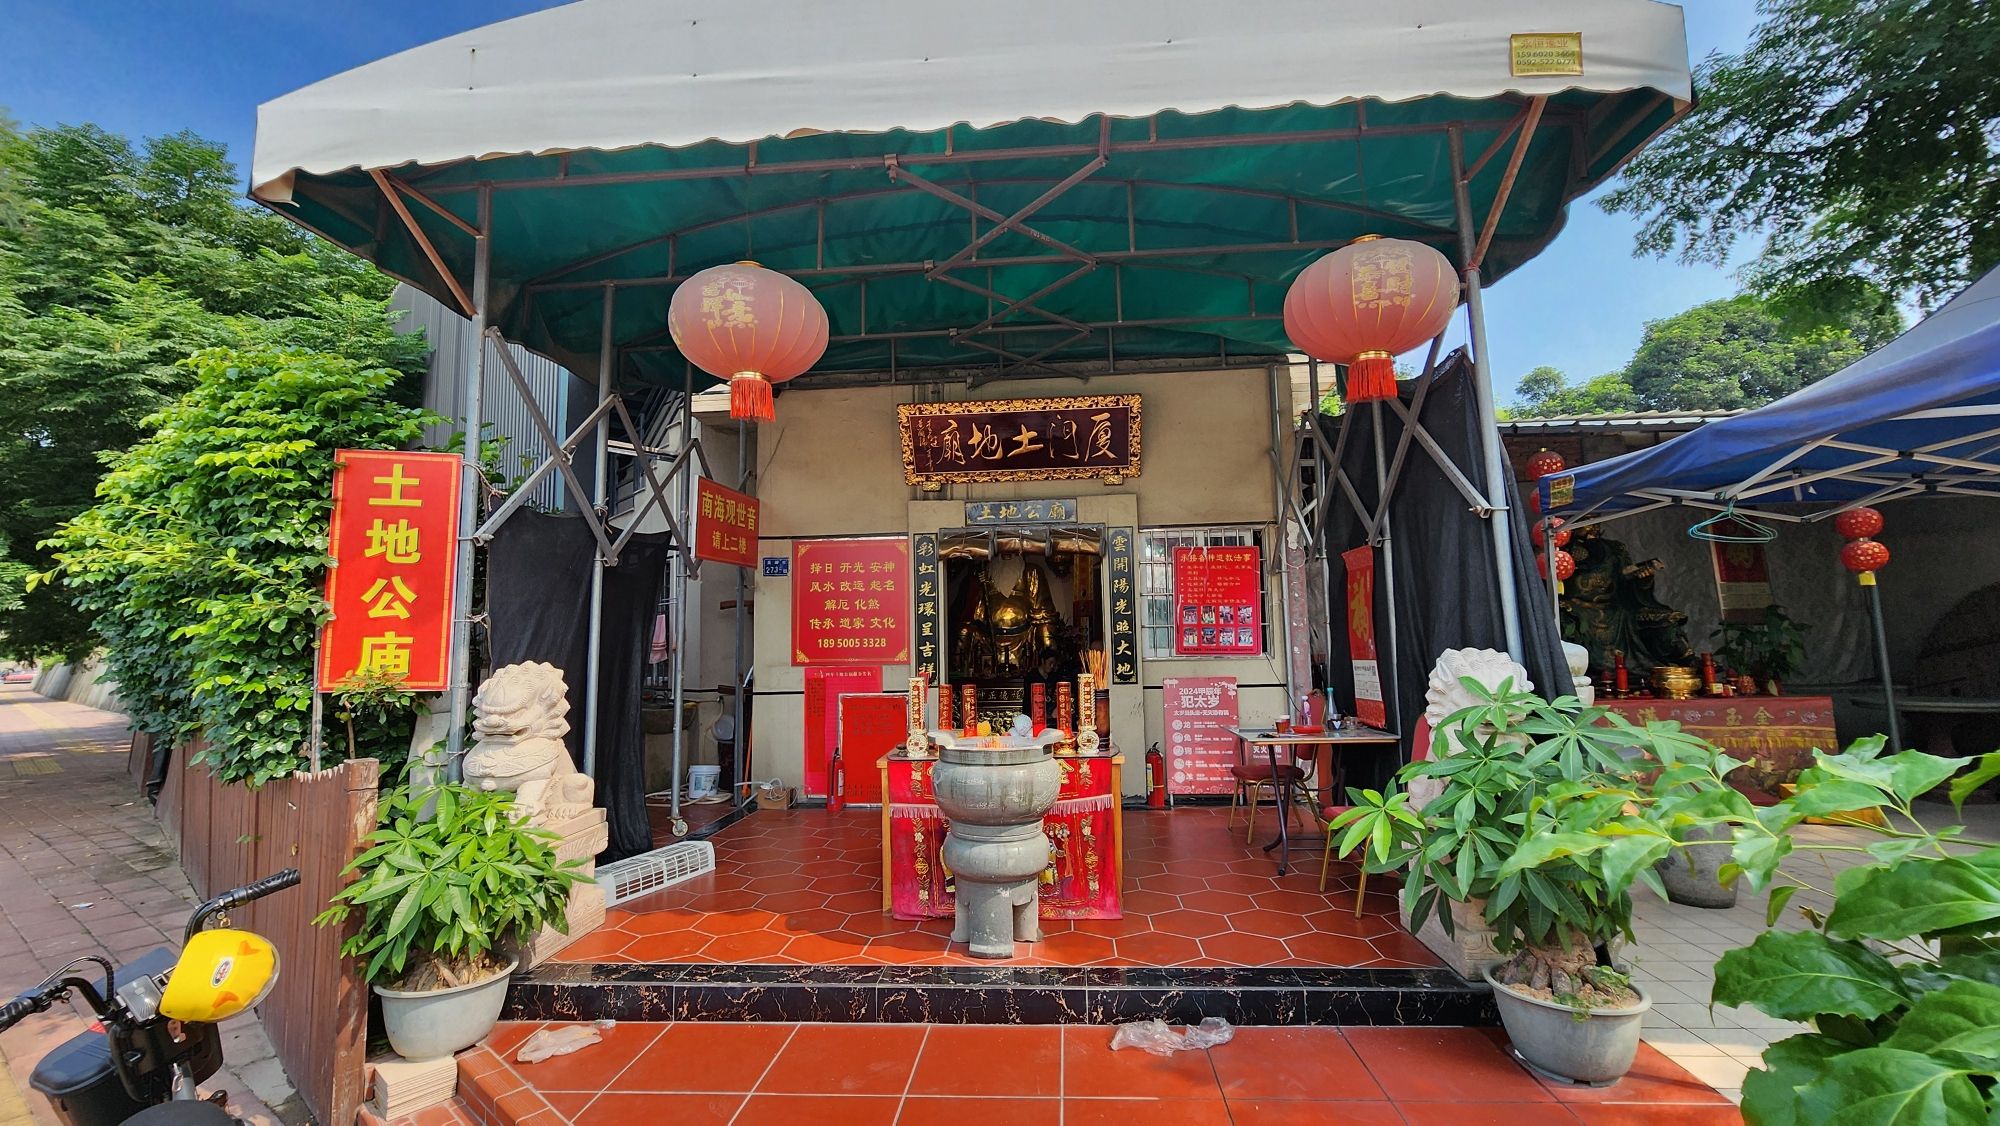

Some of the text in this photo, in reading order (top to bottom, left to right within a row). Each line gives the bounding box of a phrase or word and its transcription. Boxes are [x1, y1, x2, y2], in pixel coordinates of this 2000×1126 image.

[701, 490, 757, 532] 南海观世音
[712, 530, 748, 555] 请上二楼
[355, 463, 423, 680] 土地公庙
[810, 560, 896, 574] 择日 开光 安神
[809, 579, 896, 593] 风水 改运 起名
[824, 599, 880, 611] 解厄 化煞
[809, 617, 896, 630] 传承 道家 文化
[817, 637, 887, 649] 189 5005 3328
[1181, 695, 1220, 708] 犯太岁
